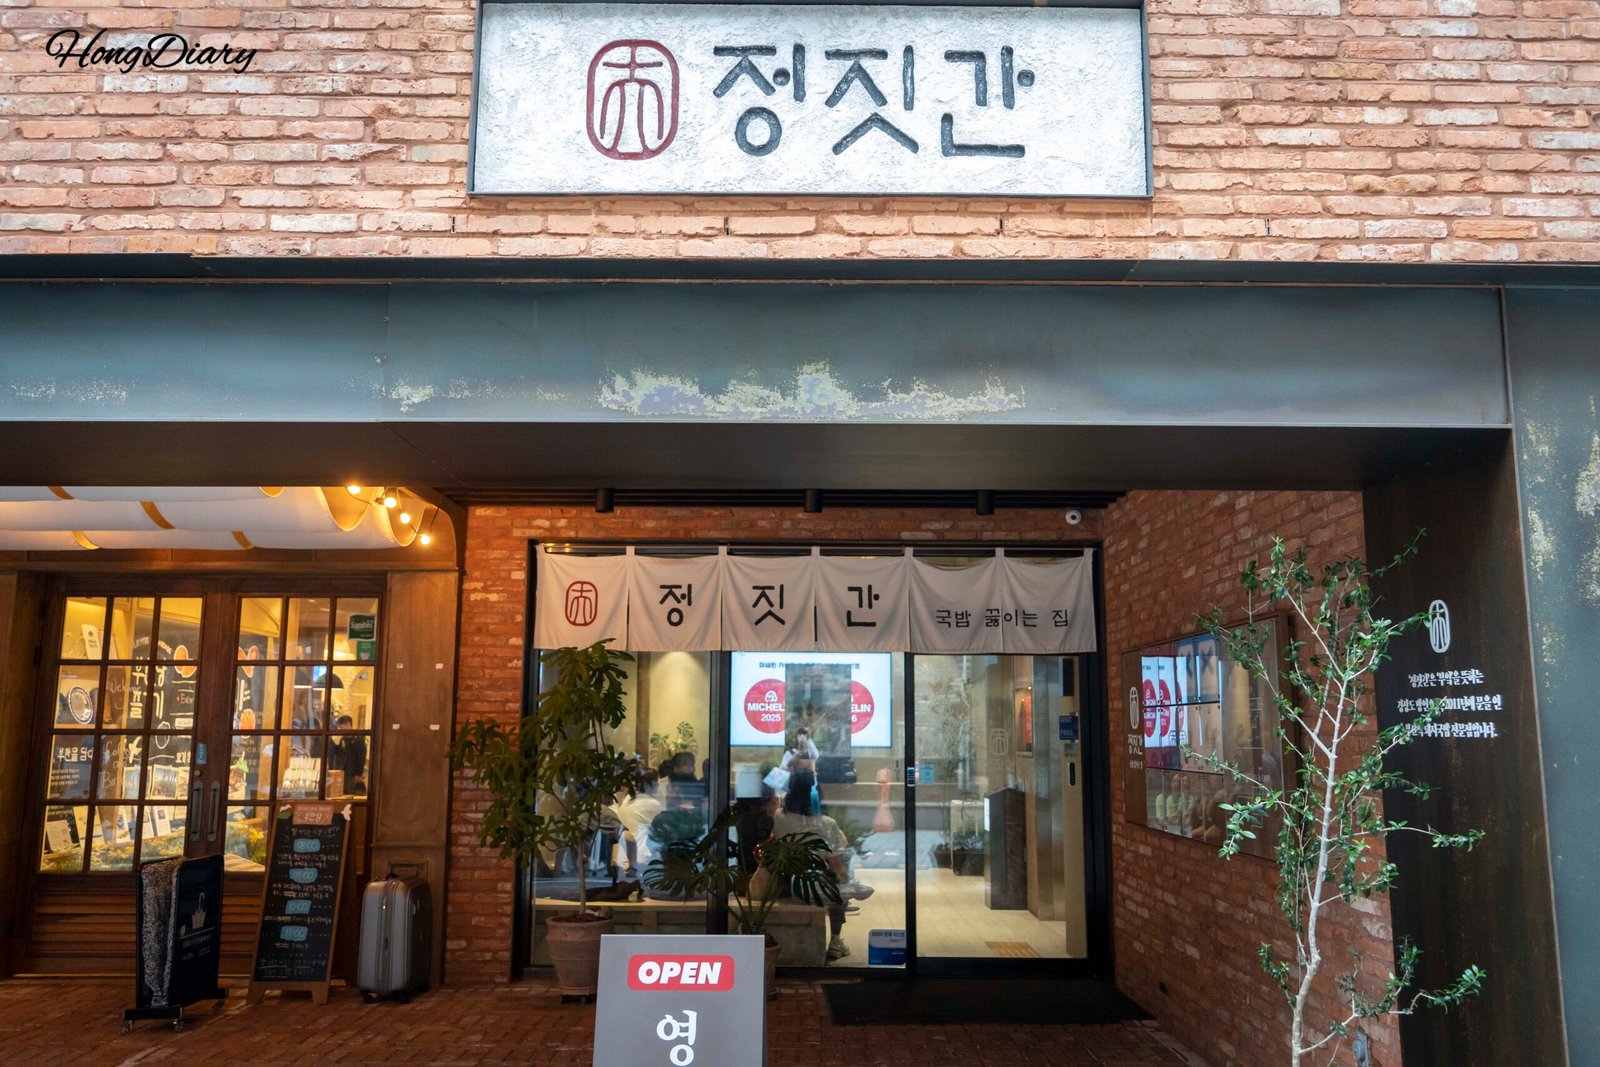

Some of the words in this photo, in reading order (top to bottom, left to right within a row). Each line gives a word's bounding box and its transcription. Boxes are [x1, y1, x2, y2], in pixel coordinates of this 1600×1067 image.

[713, 43, 1035, 157] 정짓간
[936, 609, 972, 628] 국밥
[983, 608, 1038, 628] 끓이는
[1051, 609, 1069, 628] 집
[1461, 668, 1485, 685] 뜻하는
[747, 702, 785, 712] MICHEL
[1397, 698, 1416, 713] 경상도
[1445, 696, 1475, 712] 2011년에
[1475, 695, 1492, 711] 문을
[1492, 693, 1504, 711] 연
[760, 713, 782, 722] 2025
[1424, 721, 1450, 738] 돼지국밥
[1451, 721, 1499, 739] 전문점입니다.
[637, 961, 722, 985] OPEN
[656, 1009, 698, 1067] 영
